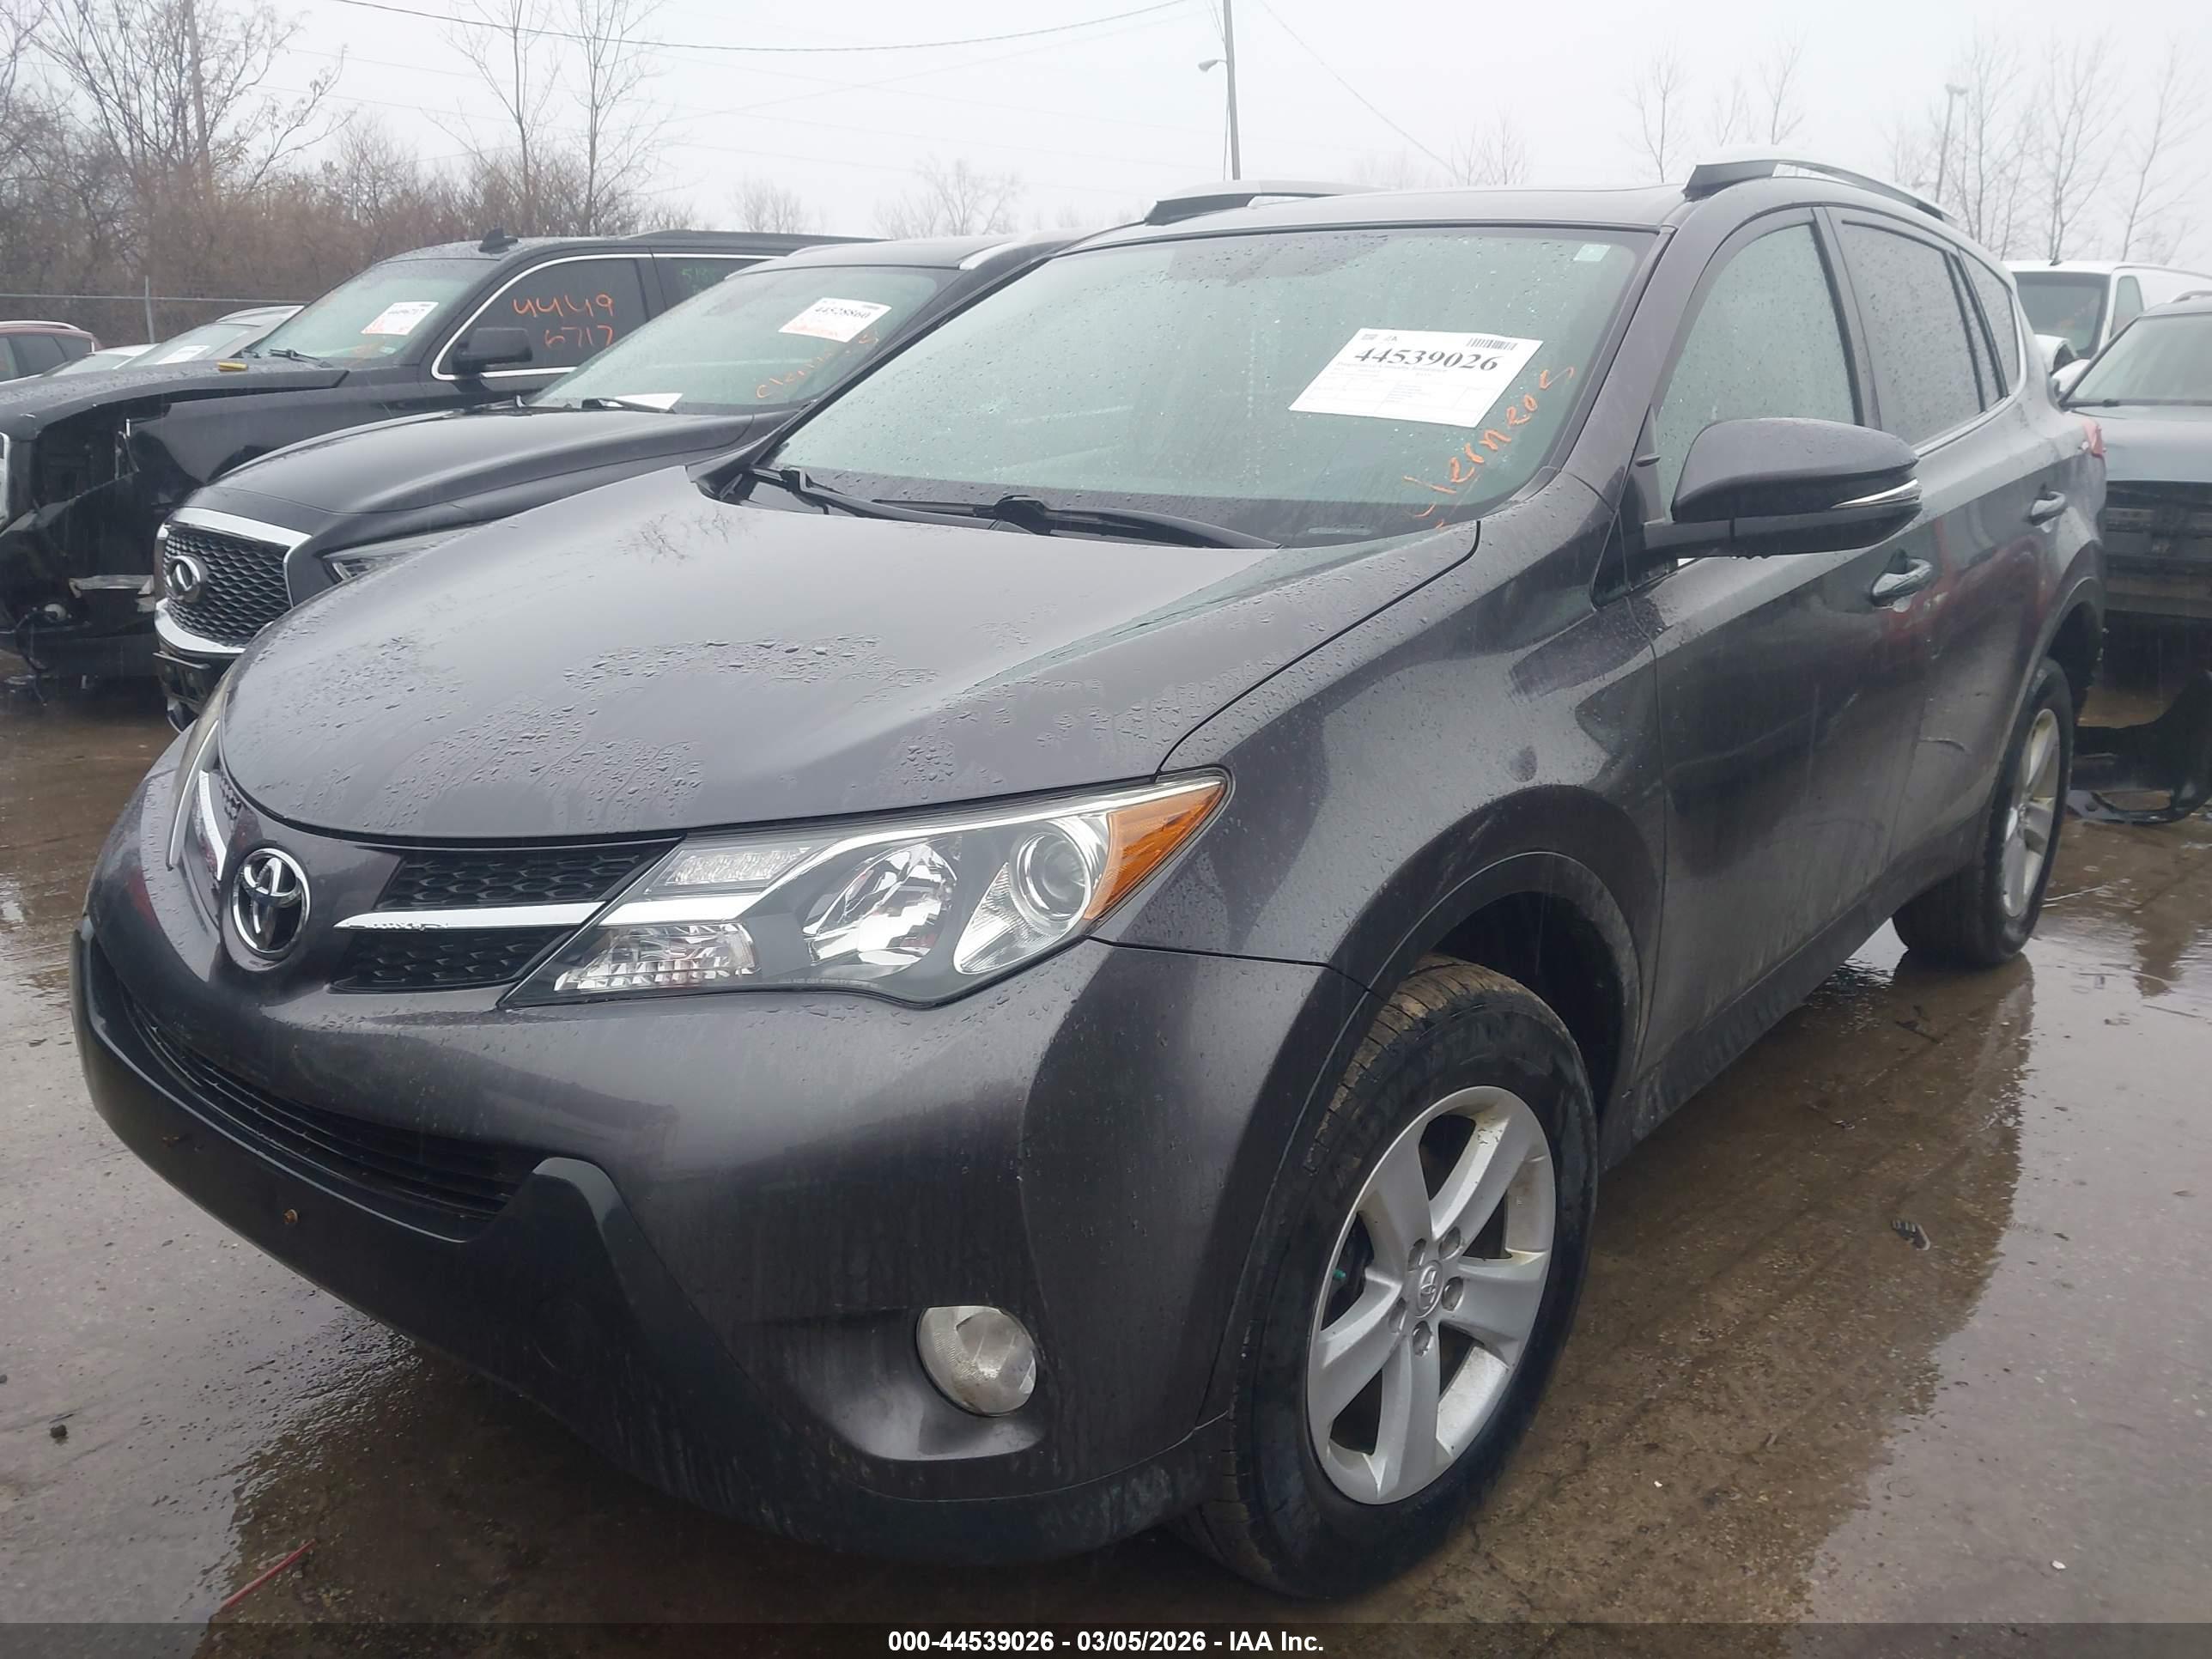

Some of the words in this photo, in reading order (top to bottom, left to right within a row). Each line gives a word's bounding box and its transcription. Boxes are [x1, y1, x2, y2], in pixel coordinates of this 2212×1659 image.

[513, 294, 613, 318] 4449
[544, 325, 613, 348] 6717
[1354, 347, 1503, 372] 44539026
